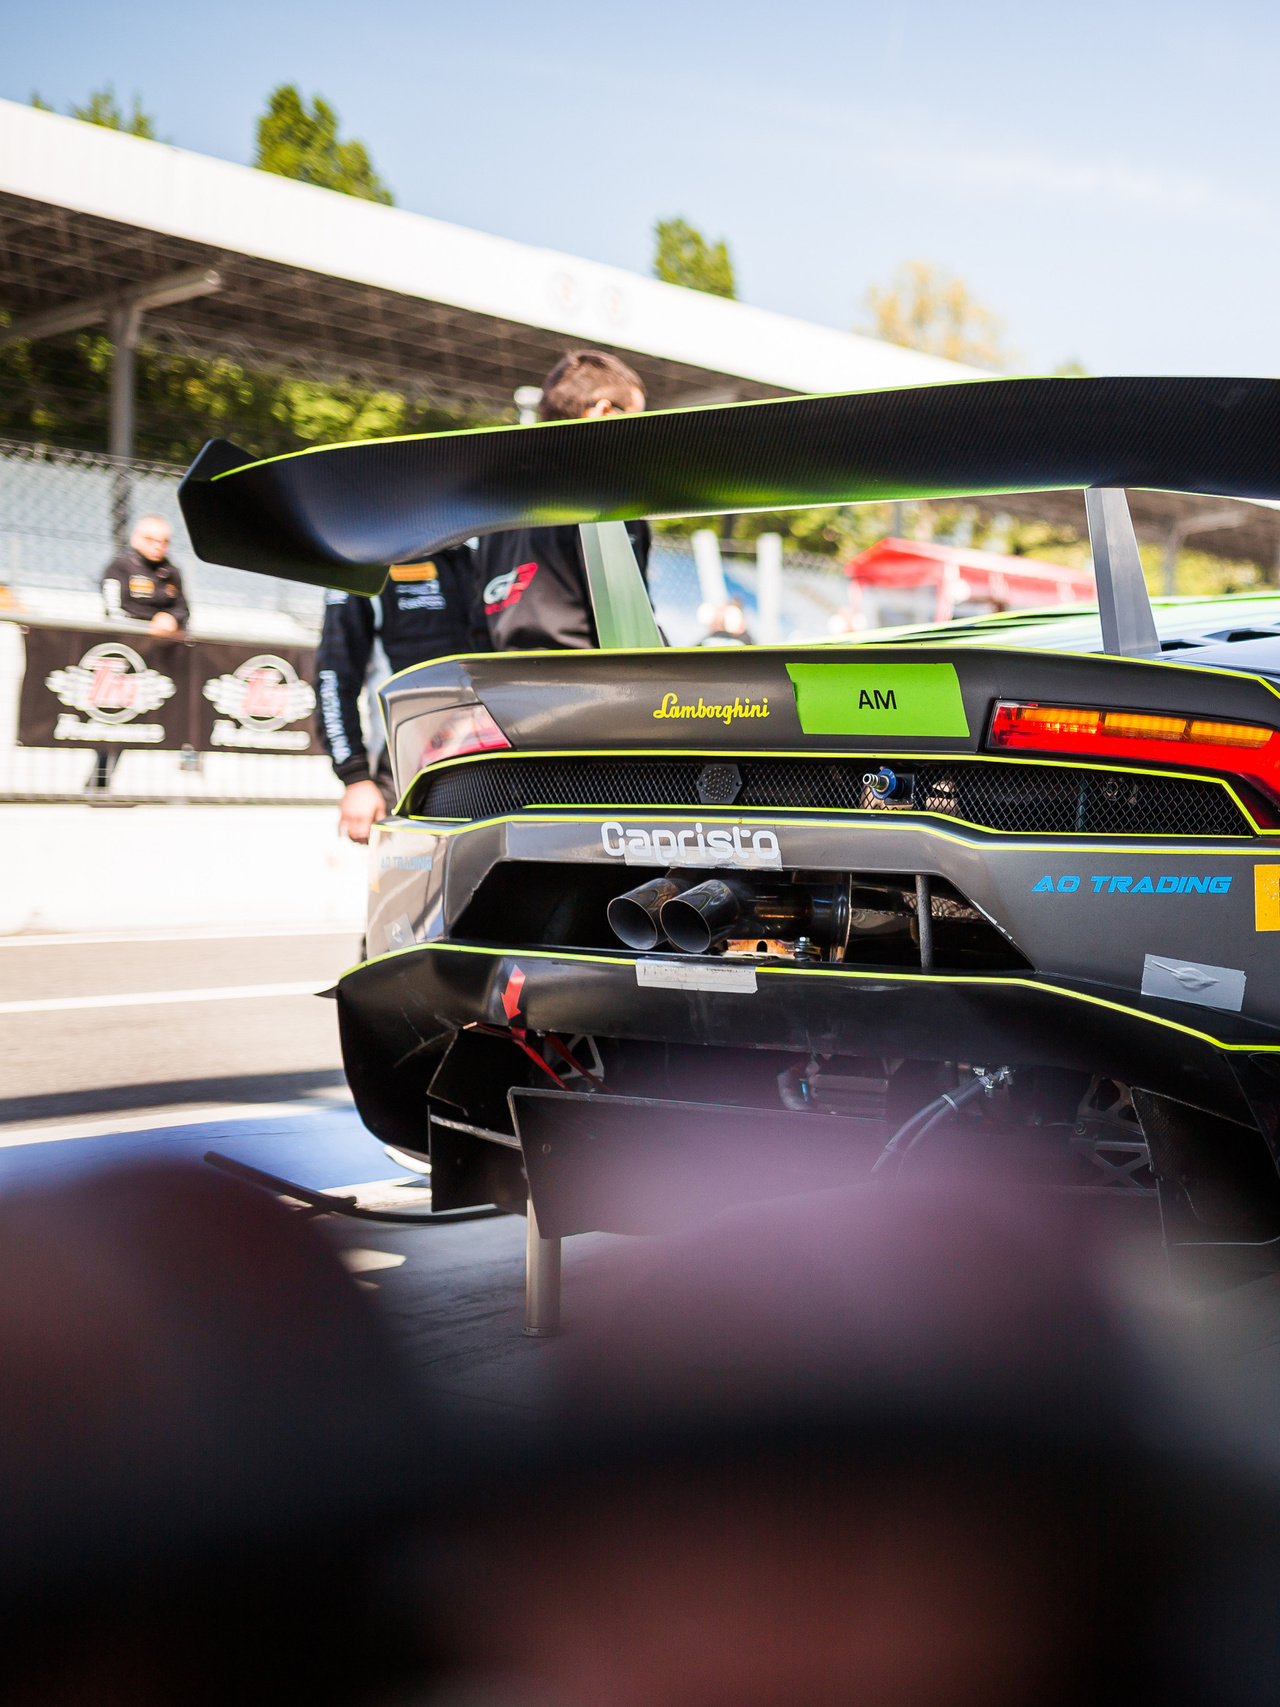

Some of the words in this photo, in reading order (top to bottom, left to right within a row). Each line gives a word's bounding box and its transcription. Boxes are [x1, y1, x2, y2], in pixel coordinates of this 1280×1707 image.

[652, 692, 770, 725] Lamborghini
[858, 689, 898, 709] AM
[600, 821, 781, 867] Capristo
[1031, 875, 1081, 893] AO
[1090, 875, 1233, 894] TRADING
